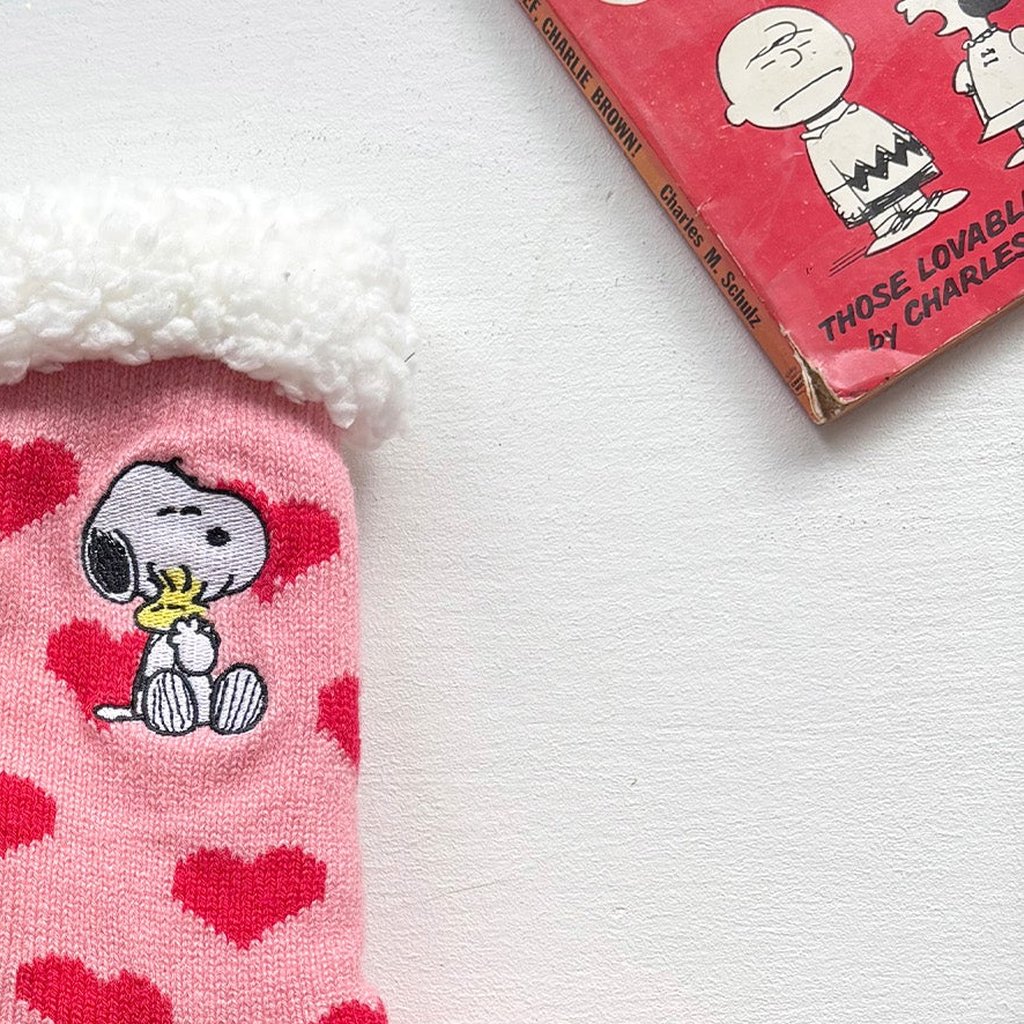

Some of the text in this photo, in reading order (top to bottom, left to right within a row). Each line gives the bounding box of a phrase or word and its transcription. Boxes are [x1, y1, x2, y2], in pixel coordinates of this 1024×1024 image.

[542, 17, 593, 89] CHARLIE
[591, 86, 642, 157] BROWN!
[660, 184, 762, 329] Charles M. Schulz
[818, 190, 1024, 341] THOSE LOVABL
